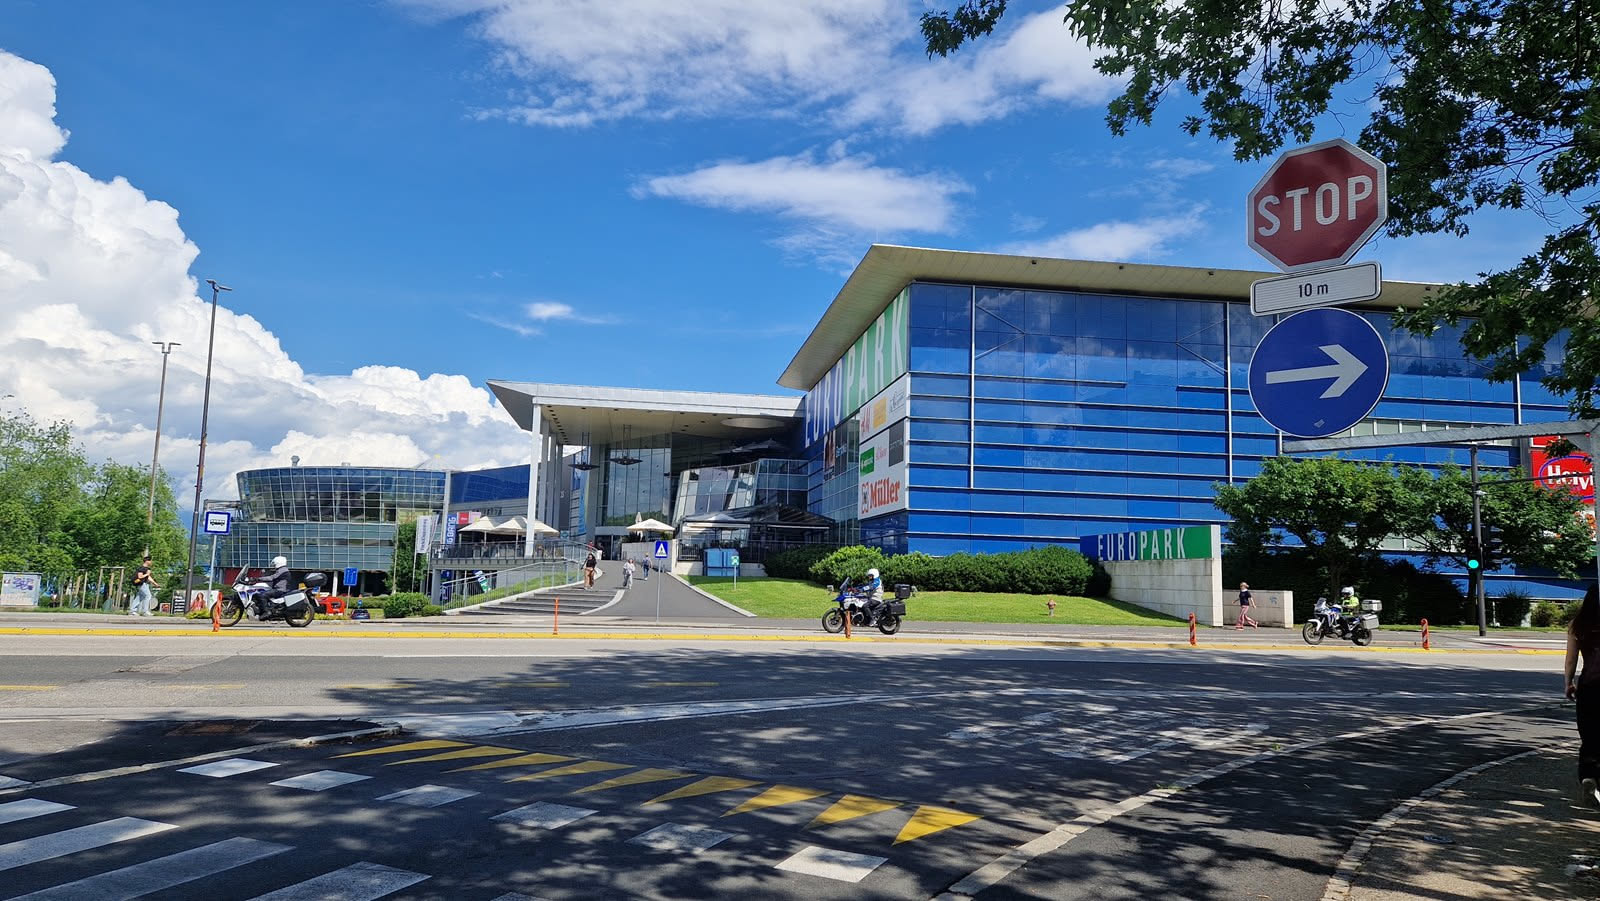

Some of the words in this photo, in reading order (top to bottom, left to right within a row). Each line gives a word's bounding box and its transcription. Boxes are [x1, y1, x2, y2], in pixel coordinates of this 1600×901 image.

[1257, 175, 1373, 237] STOP
[1298, 283, 1312, 298] 10
[1317, 284, 1329, 295] m
[805, 287, 906, 449] EUROPARK
[870, 477, 901, 509] Müller
[1547, 465, 1594, 490] Hervi
[1097, 527, 1186, 560] EUROPARK
